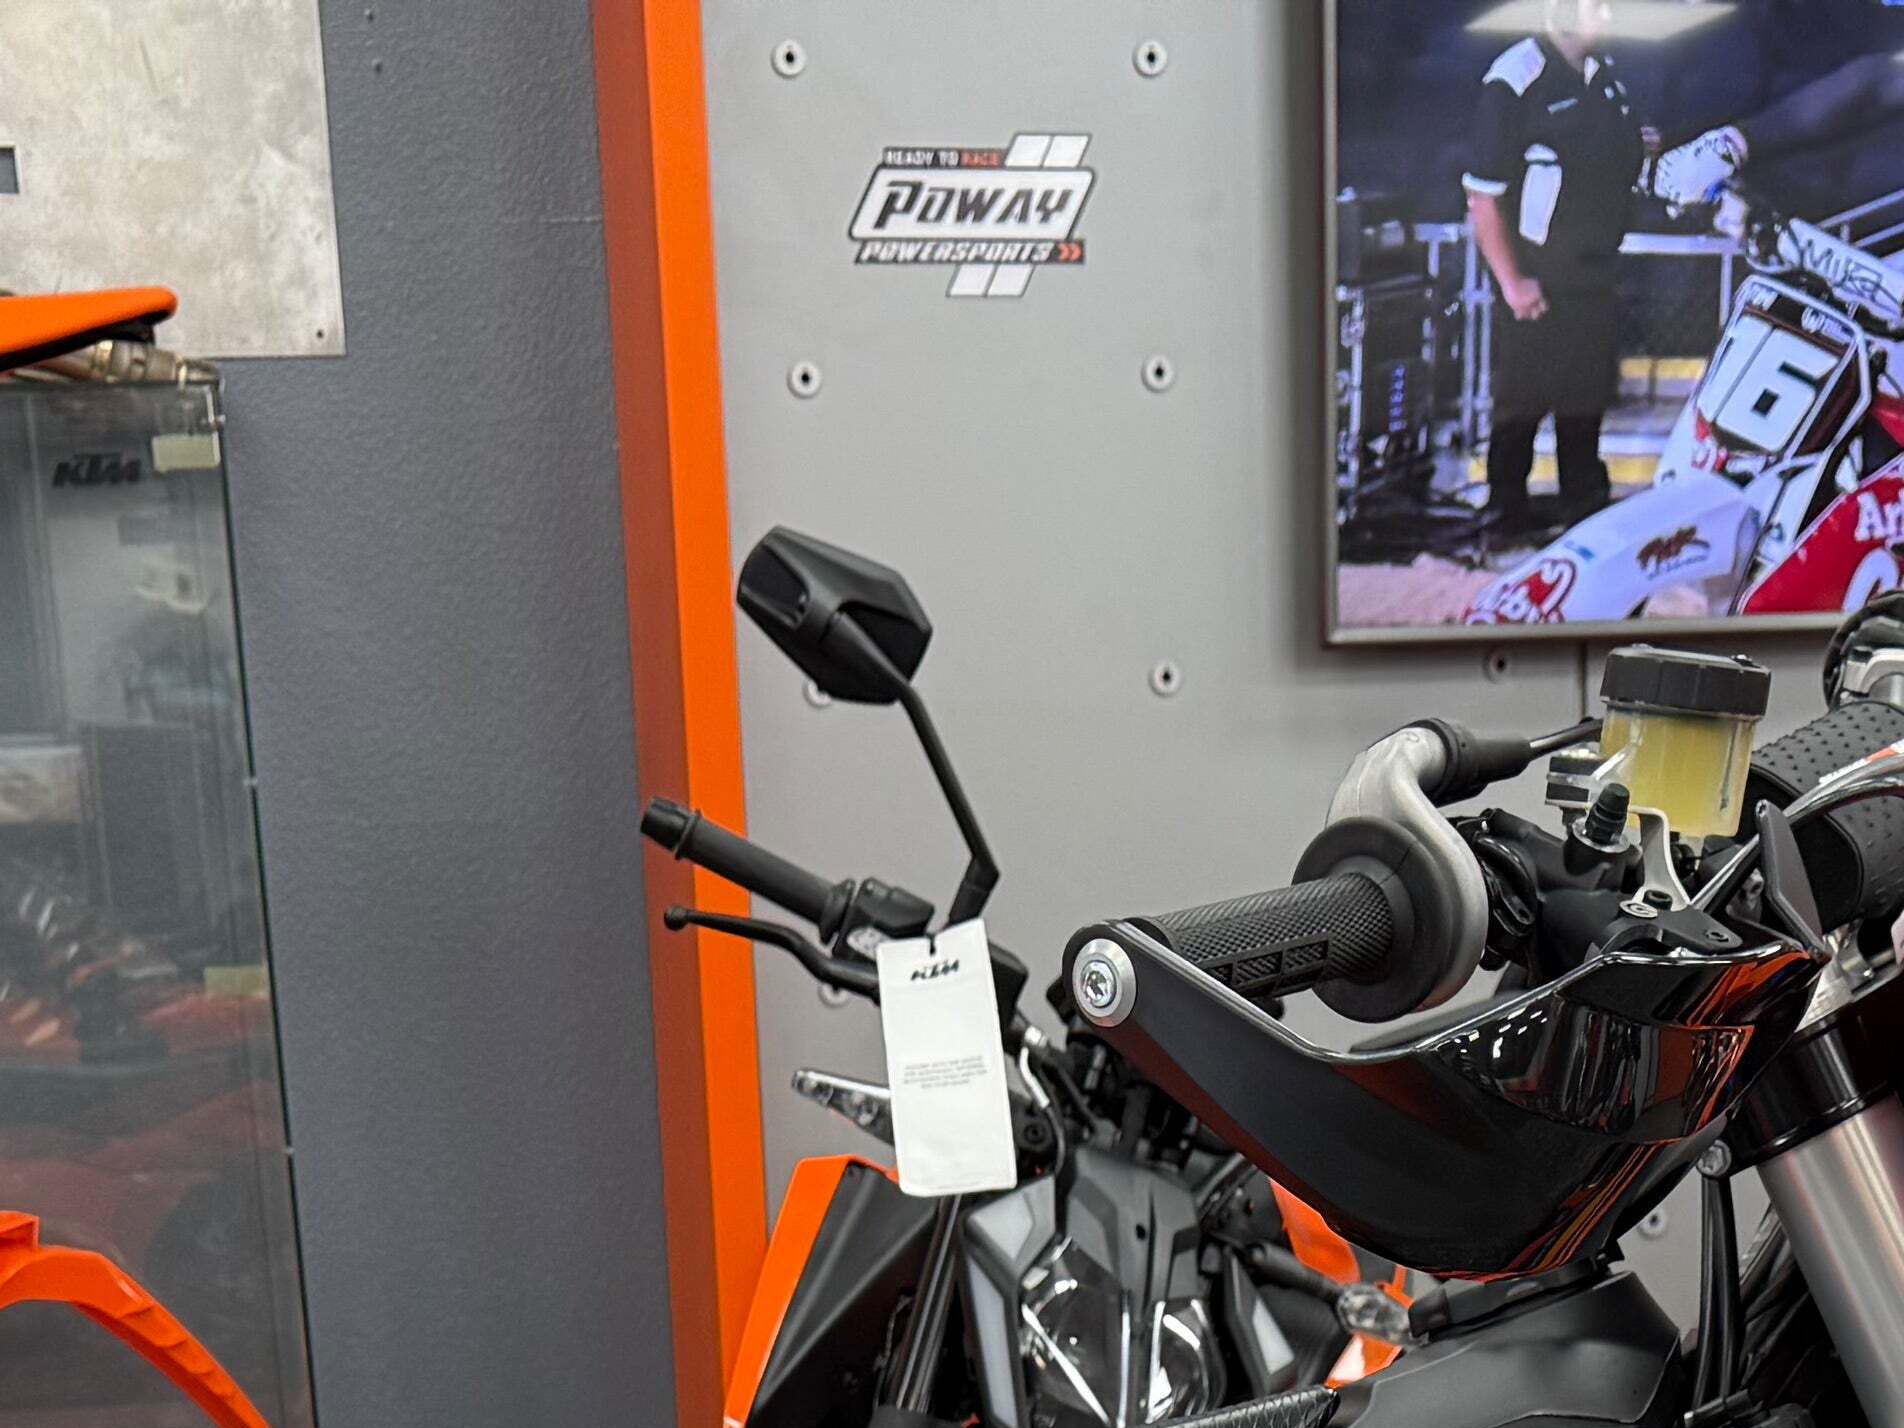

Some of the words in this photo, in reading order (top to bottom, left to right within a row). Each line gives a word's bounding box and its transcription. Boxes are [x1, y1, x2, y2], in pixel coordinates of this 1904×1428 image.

[886, 150, 934, 165] READY
[938, 150, 959, 165] TO
[873, 181, 1073, 229] POWAY
[860, 241, 1055, 262] POWERSPORTS
